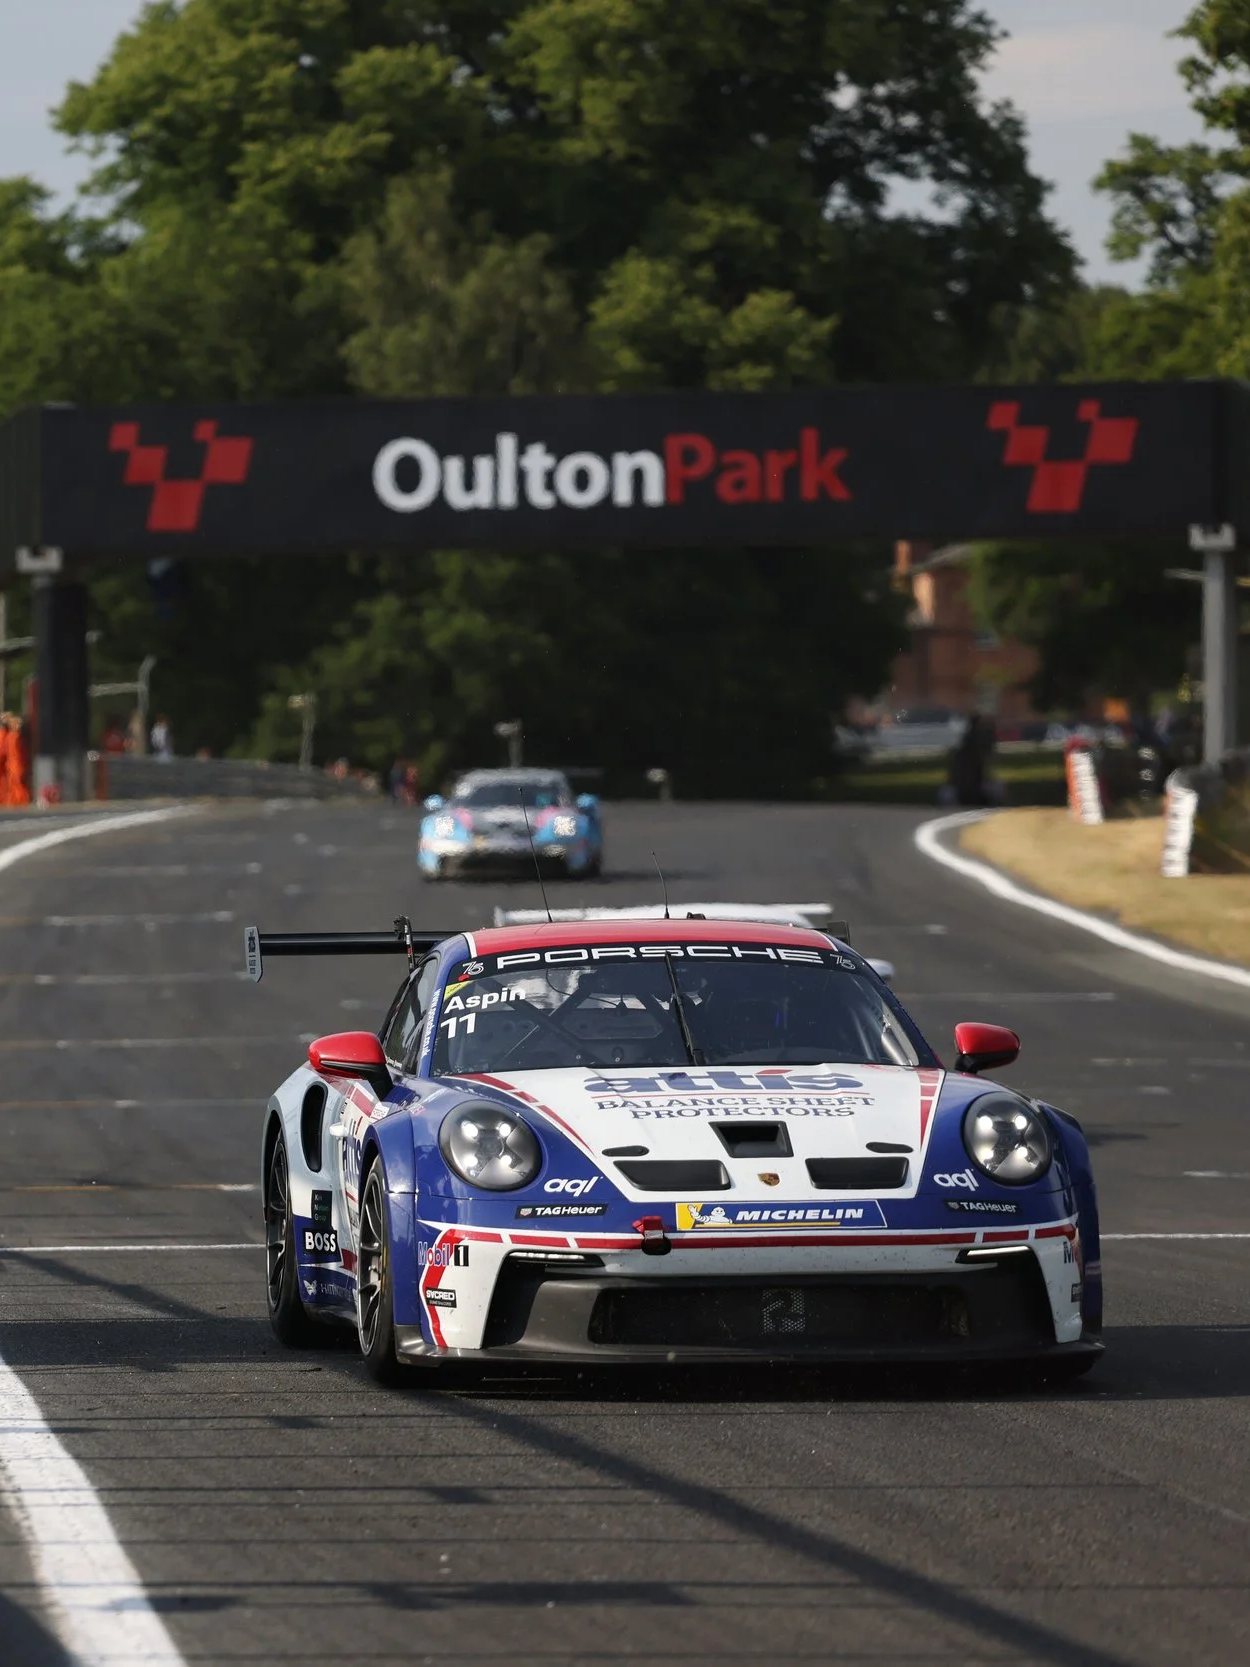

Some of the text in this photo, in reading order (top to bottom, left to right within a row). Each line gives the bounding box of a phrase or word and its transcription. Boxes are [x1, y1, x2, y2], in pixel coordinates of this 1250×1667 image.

[496, 945, 824, 969] PORSCHE
[444, 987, 526, 1014] Aspin
[440, 1013, 476, 1039] 11
[583, 1069, 864, 1092] attis
[597, 1096, 875, 1110] BALANCE SHEET
[630, 1106, 855, 1119] PROTECTORS
[544, 1176, 600, 1197] aql
[934, 1169, 979, 1191] aql
[736, 1208, 863, 1221] MICHELIN
[305, 1231, 336, 1252] BOSS
[418, 1241, 450, 1267] Mobil
